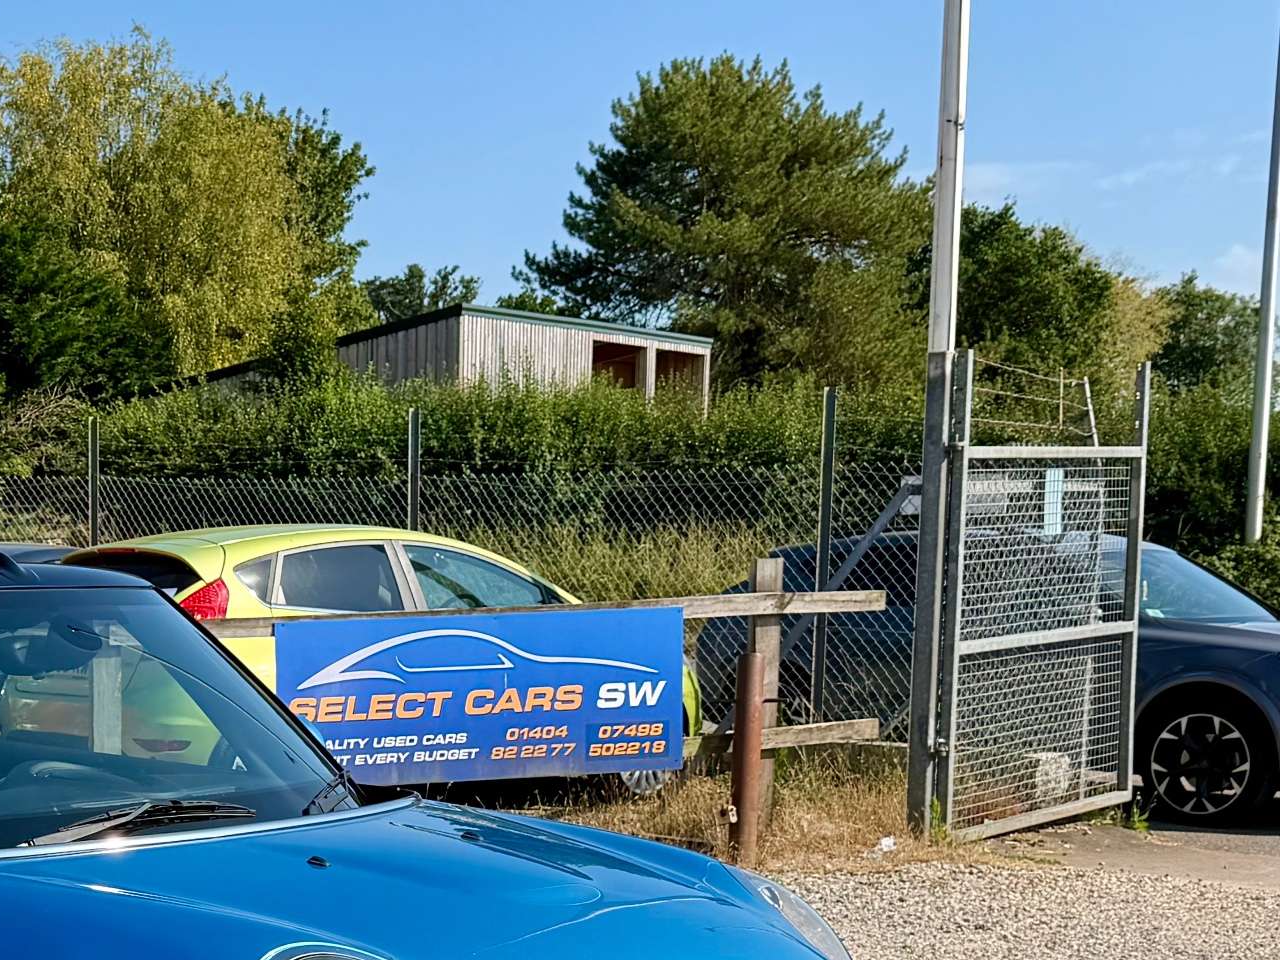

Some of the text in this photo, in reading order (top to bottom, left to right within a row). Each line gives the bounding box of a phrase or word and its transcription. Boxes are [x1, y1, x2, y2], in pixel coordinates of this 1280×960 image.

[289, 680, 667, 722] SELECT CARS SW
[505, 725, 569, 742] 01404
[598, 722, 664, 740] 07498
[325, 732, 468, 751] ALITY USED CARS
[588, 740, 666, 757] 502218
[354, 751, 410, 766] EVERY
[413, 748, 480, 763] BUDGET
